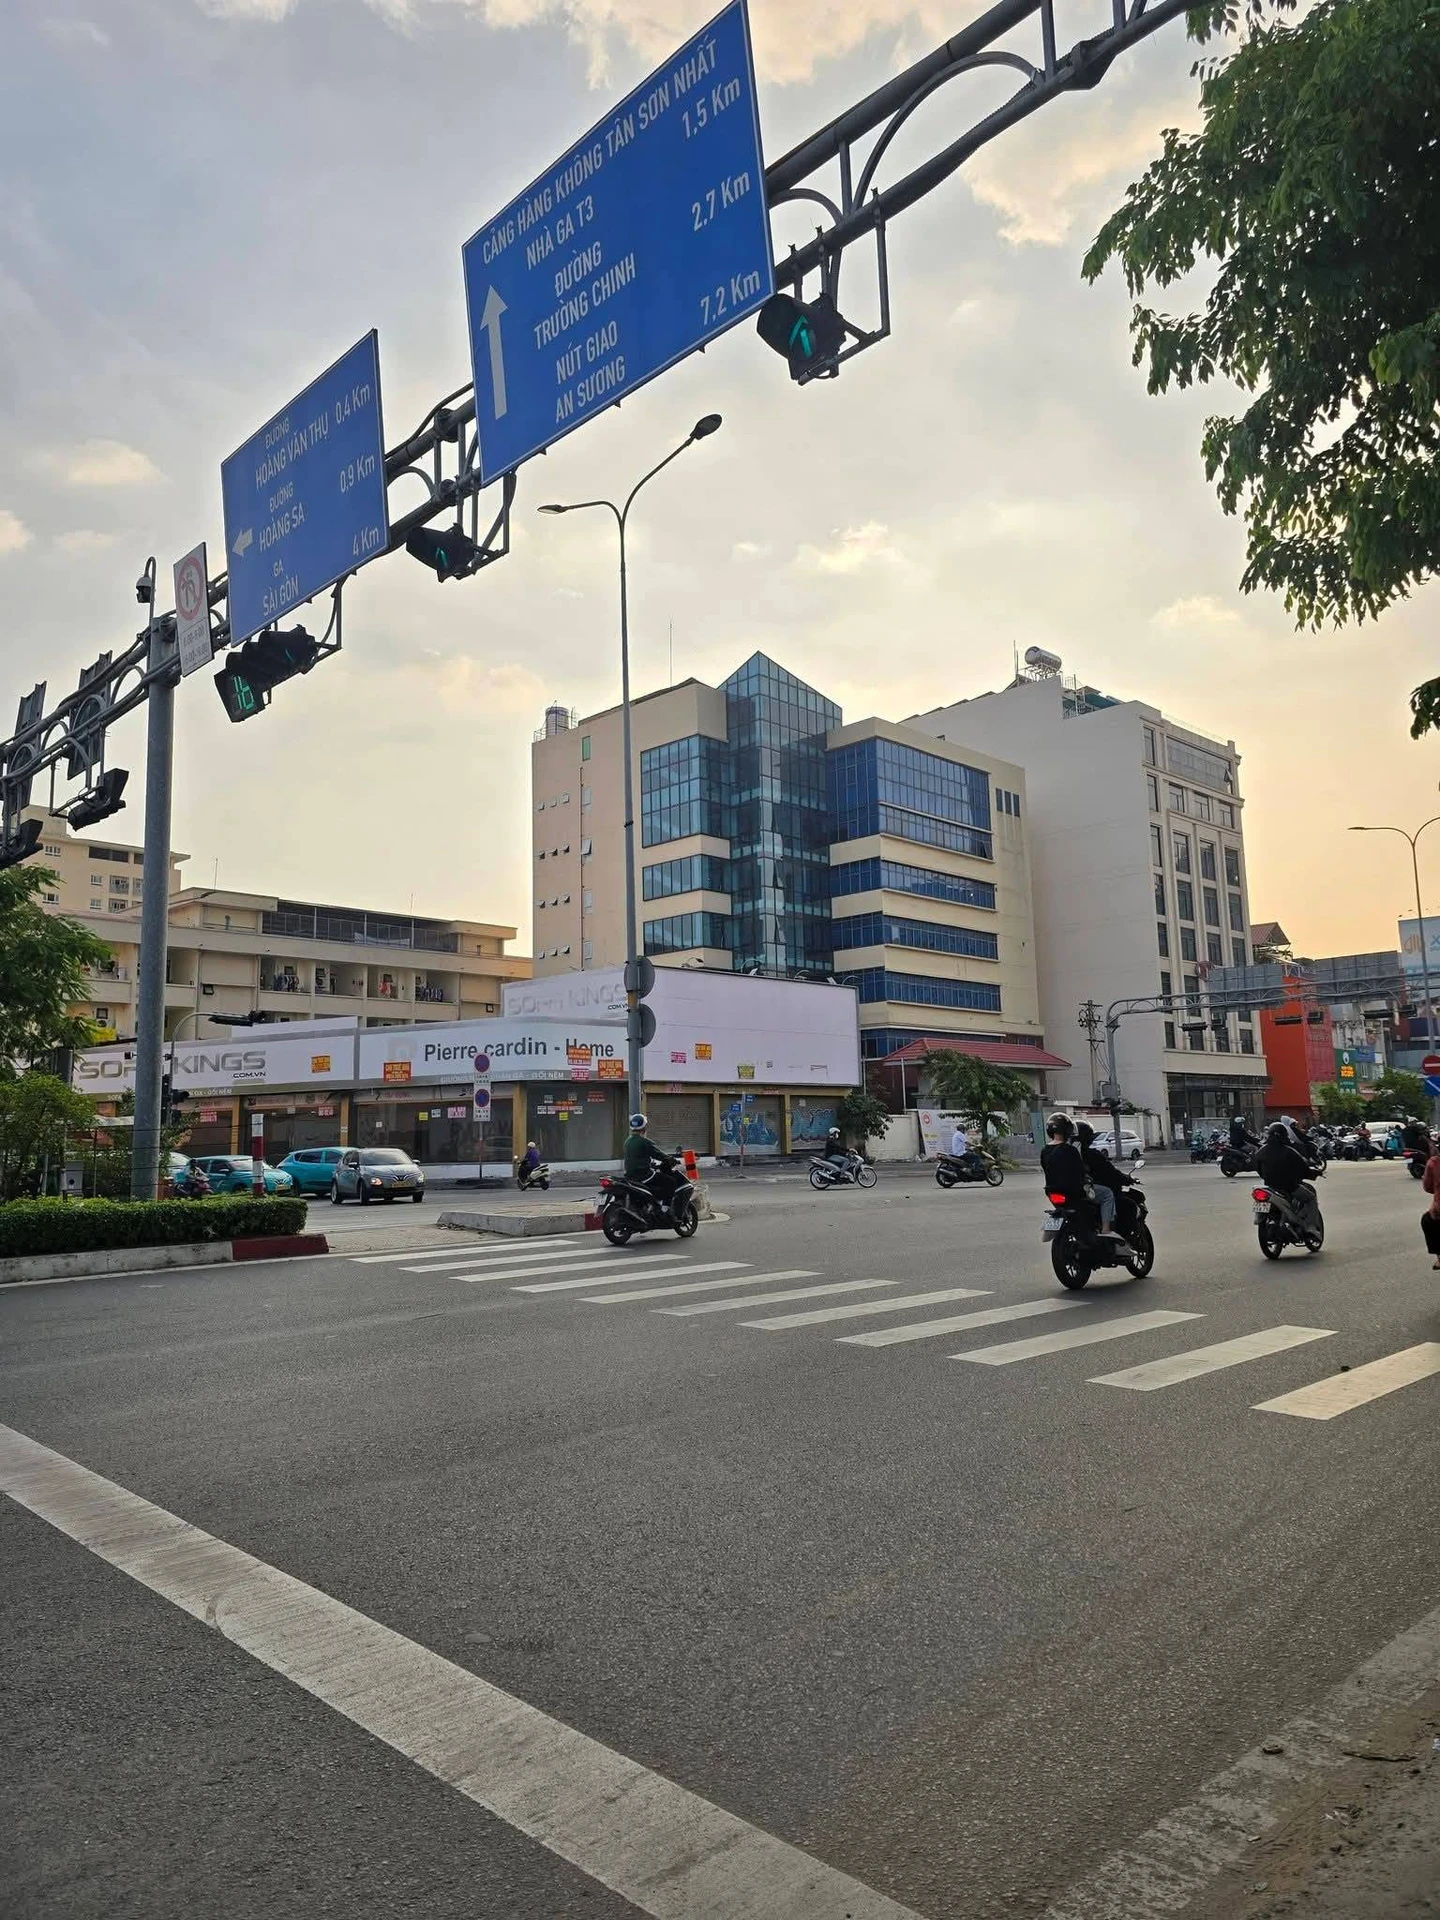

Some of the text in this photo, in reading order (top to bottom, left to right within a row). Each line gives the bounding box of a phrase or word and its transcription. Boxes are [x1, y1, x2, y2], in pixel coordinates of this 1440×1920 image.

[711, 77, 742, 118] Km
[482, 34, 718, 265] CẢNG HÀNG KHÔNG TÂN SƠN NHẤT
[720, 171, 751, 210] Km
[525, 194, 595, 271] NHÀ GA T3
[554, 240, 602, 298] ĐƯỜNG
[730, 269, 761, 307] Km
[533, 252, 637, 351] TRƯỜNG CHINH
[555, 320, 619, 385] NÚT GIAO
[351, 383, 371, 412] Km
[555, 354, 626, 425] AN SƯƠNG
[254, 411, 330, 491] HOÀNG VĂN THỤ
[264, 417, 291, 450] ĐƯỜNG
[355, 454, 376, 481] Km
[268, 481, 295, 514] ĐƯỜNG
[259, 502, 306, 552] HOÀNG SA
[352, 525, 381, 557] 4 Km
[272, 558, 285, 578] GA
[261, 574, 300, 618] SÀI GÒN
[173, 1050, 267, 1075] KINGS
[425, 1043, 479, 1062] Pierre
[484, 1037, 547, 1057] cardin
